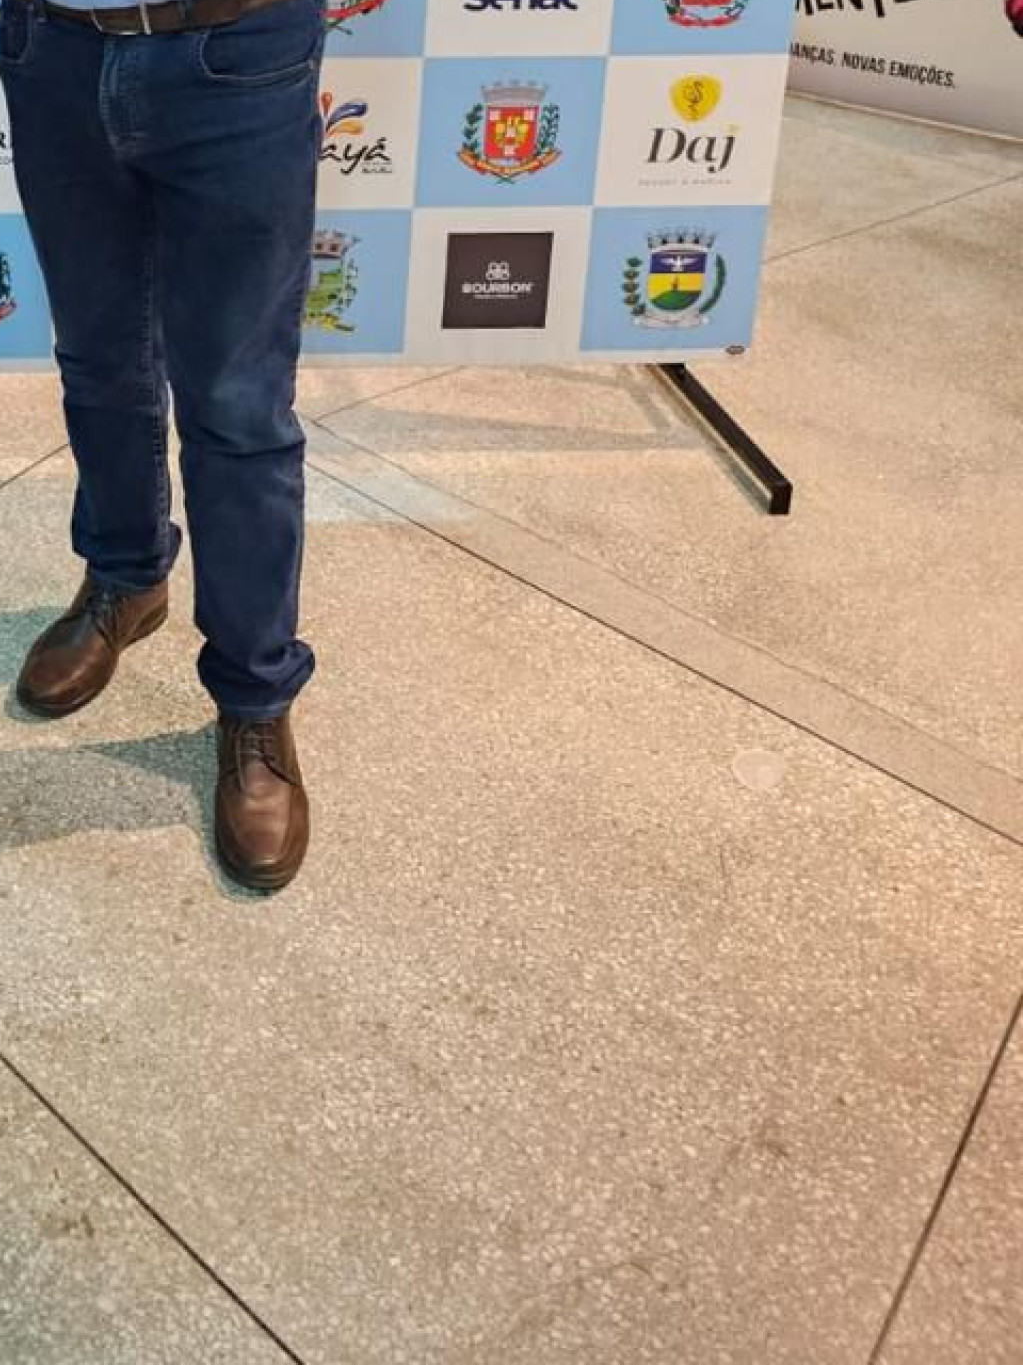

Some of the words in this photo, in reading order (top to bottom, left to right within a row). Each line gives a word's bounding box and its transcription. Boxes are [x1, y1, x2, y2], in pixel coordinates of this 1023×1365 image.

[841, 52, 885, 74] NOVAS
[646, 125, 740, 173] Daj
[462, 282, 531, 294] BOURBON
